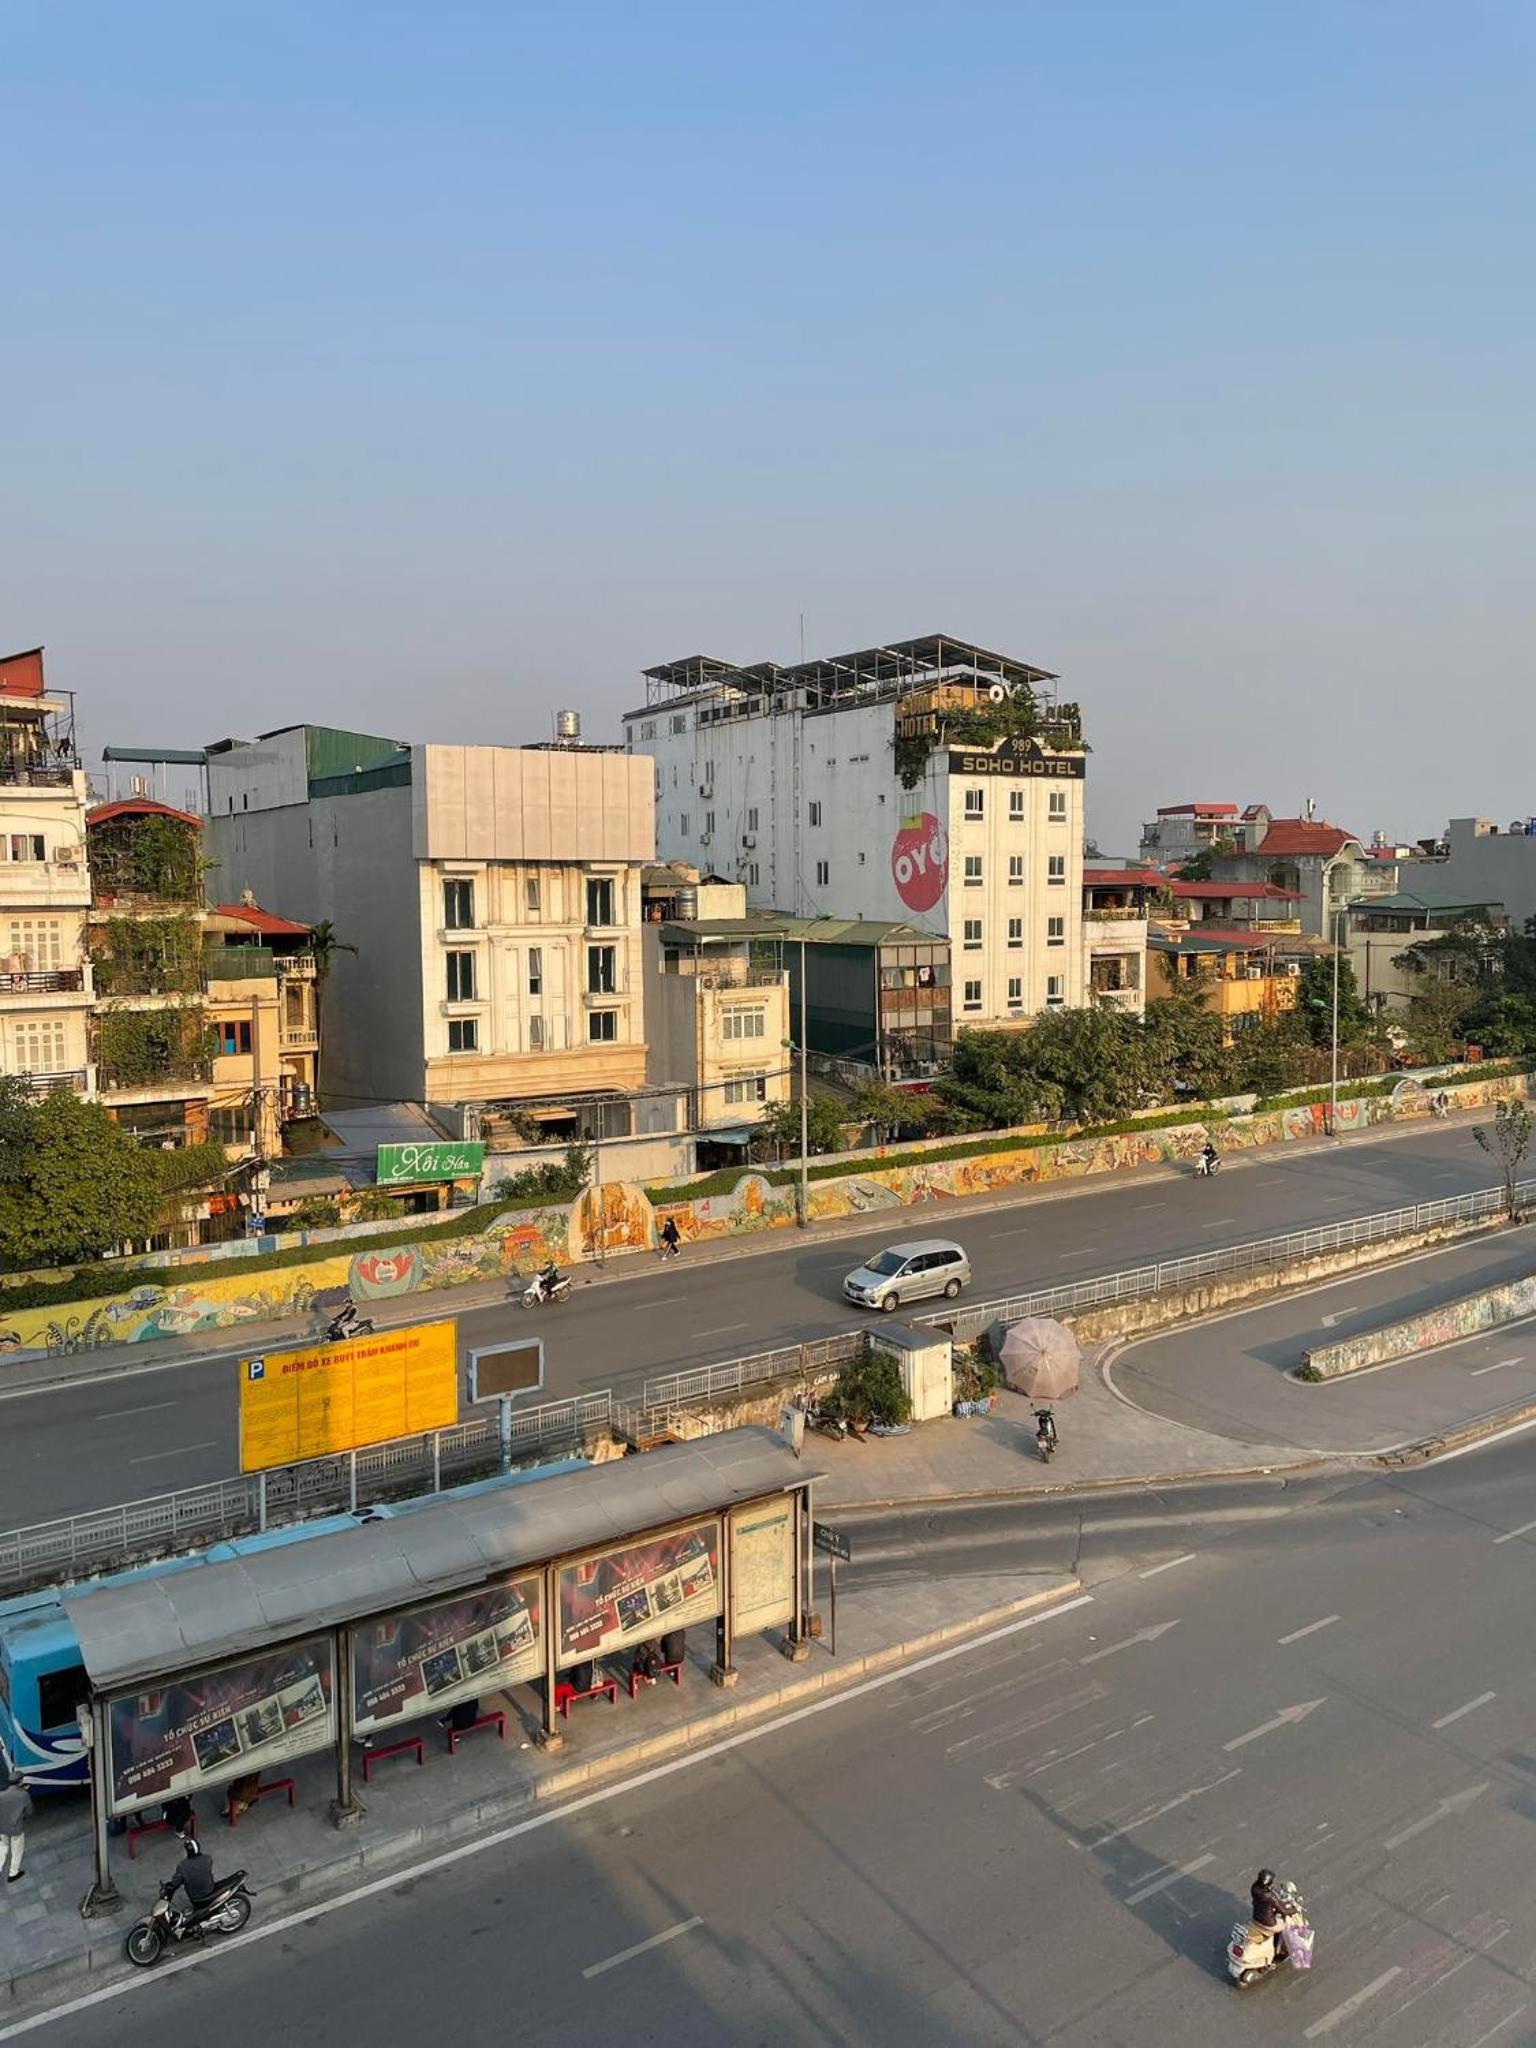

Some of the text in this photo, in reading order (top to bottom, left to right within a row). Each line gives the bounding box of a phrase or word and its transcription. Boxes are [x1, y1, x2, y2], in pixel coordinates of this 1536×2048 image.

[1011, 738, 1032, 753] 989
[962, 757, 1077, 775] SOHO HOTEL
[895, 836, 948, 884] OYO
[250, 1362, 263, 1378] P
